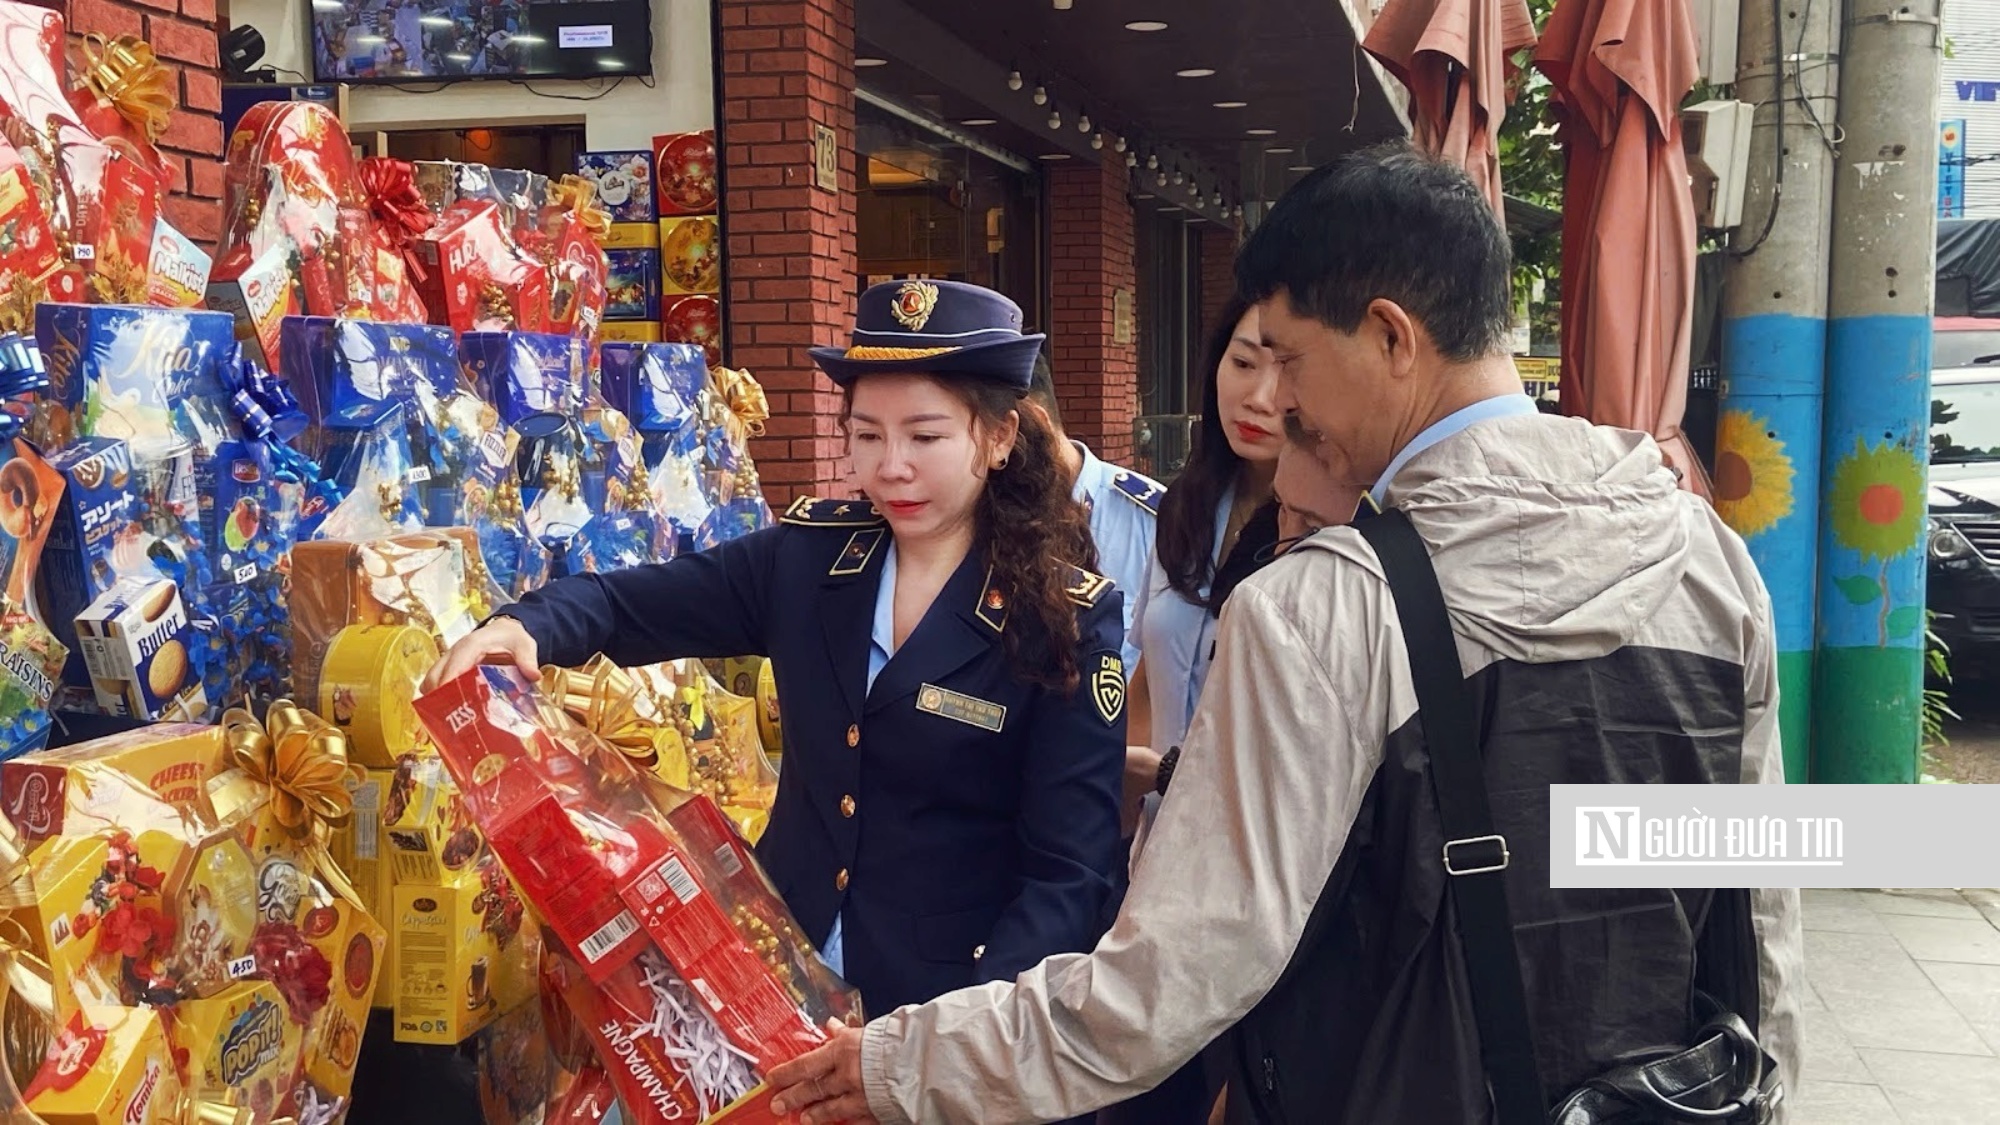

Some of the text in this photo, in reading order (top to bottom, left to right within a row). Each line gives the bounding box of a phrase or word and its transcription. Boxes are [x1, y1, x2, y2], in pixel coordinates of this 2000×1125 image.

[818, 131, 834, 172] 73
[153, 250, 206, 296] Malkist
[81, 490, 135, 532] アソート
[138, 612, 179, 658] Butter
[445, 701, 477, 734] ZESS
[401, 1021, 417, 1031] FDA
[599, 1019, 682, 1121] CHAMPAGNE
